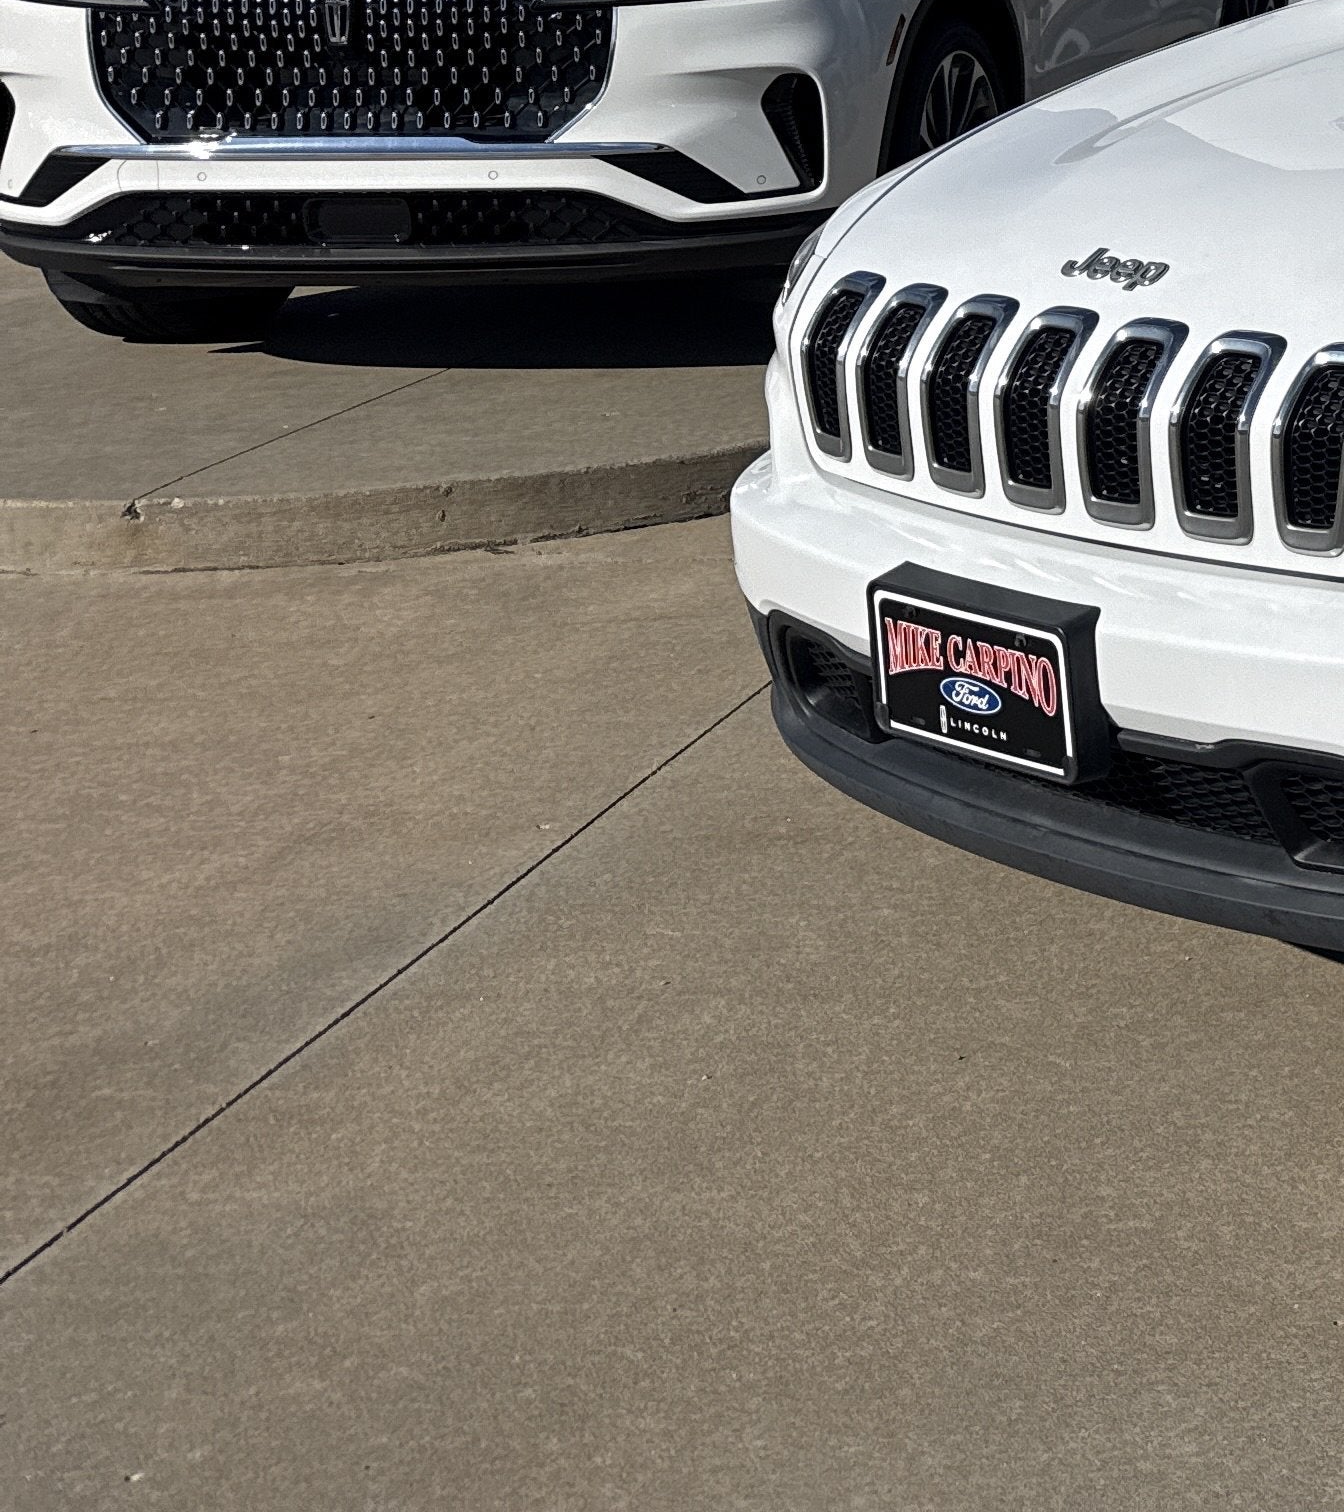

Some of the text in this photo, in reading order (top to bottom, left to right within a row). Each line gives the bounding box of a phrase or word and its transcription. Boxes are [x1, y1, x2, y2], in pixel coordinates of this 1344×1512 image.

[1060, 247, 1171, 292] Jeep
[884, 617, 1057, 717] MIKE CARPINO
[951, 680, 990, 710] Ford
[949, 717, 1008, 742] LINCOLN
